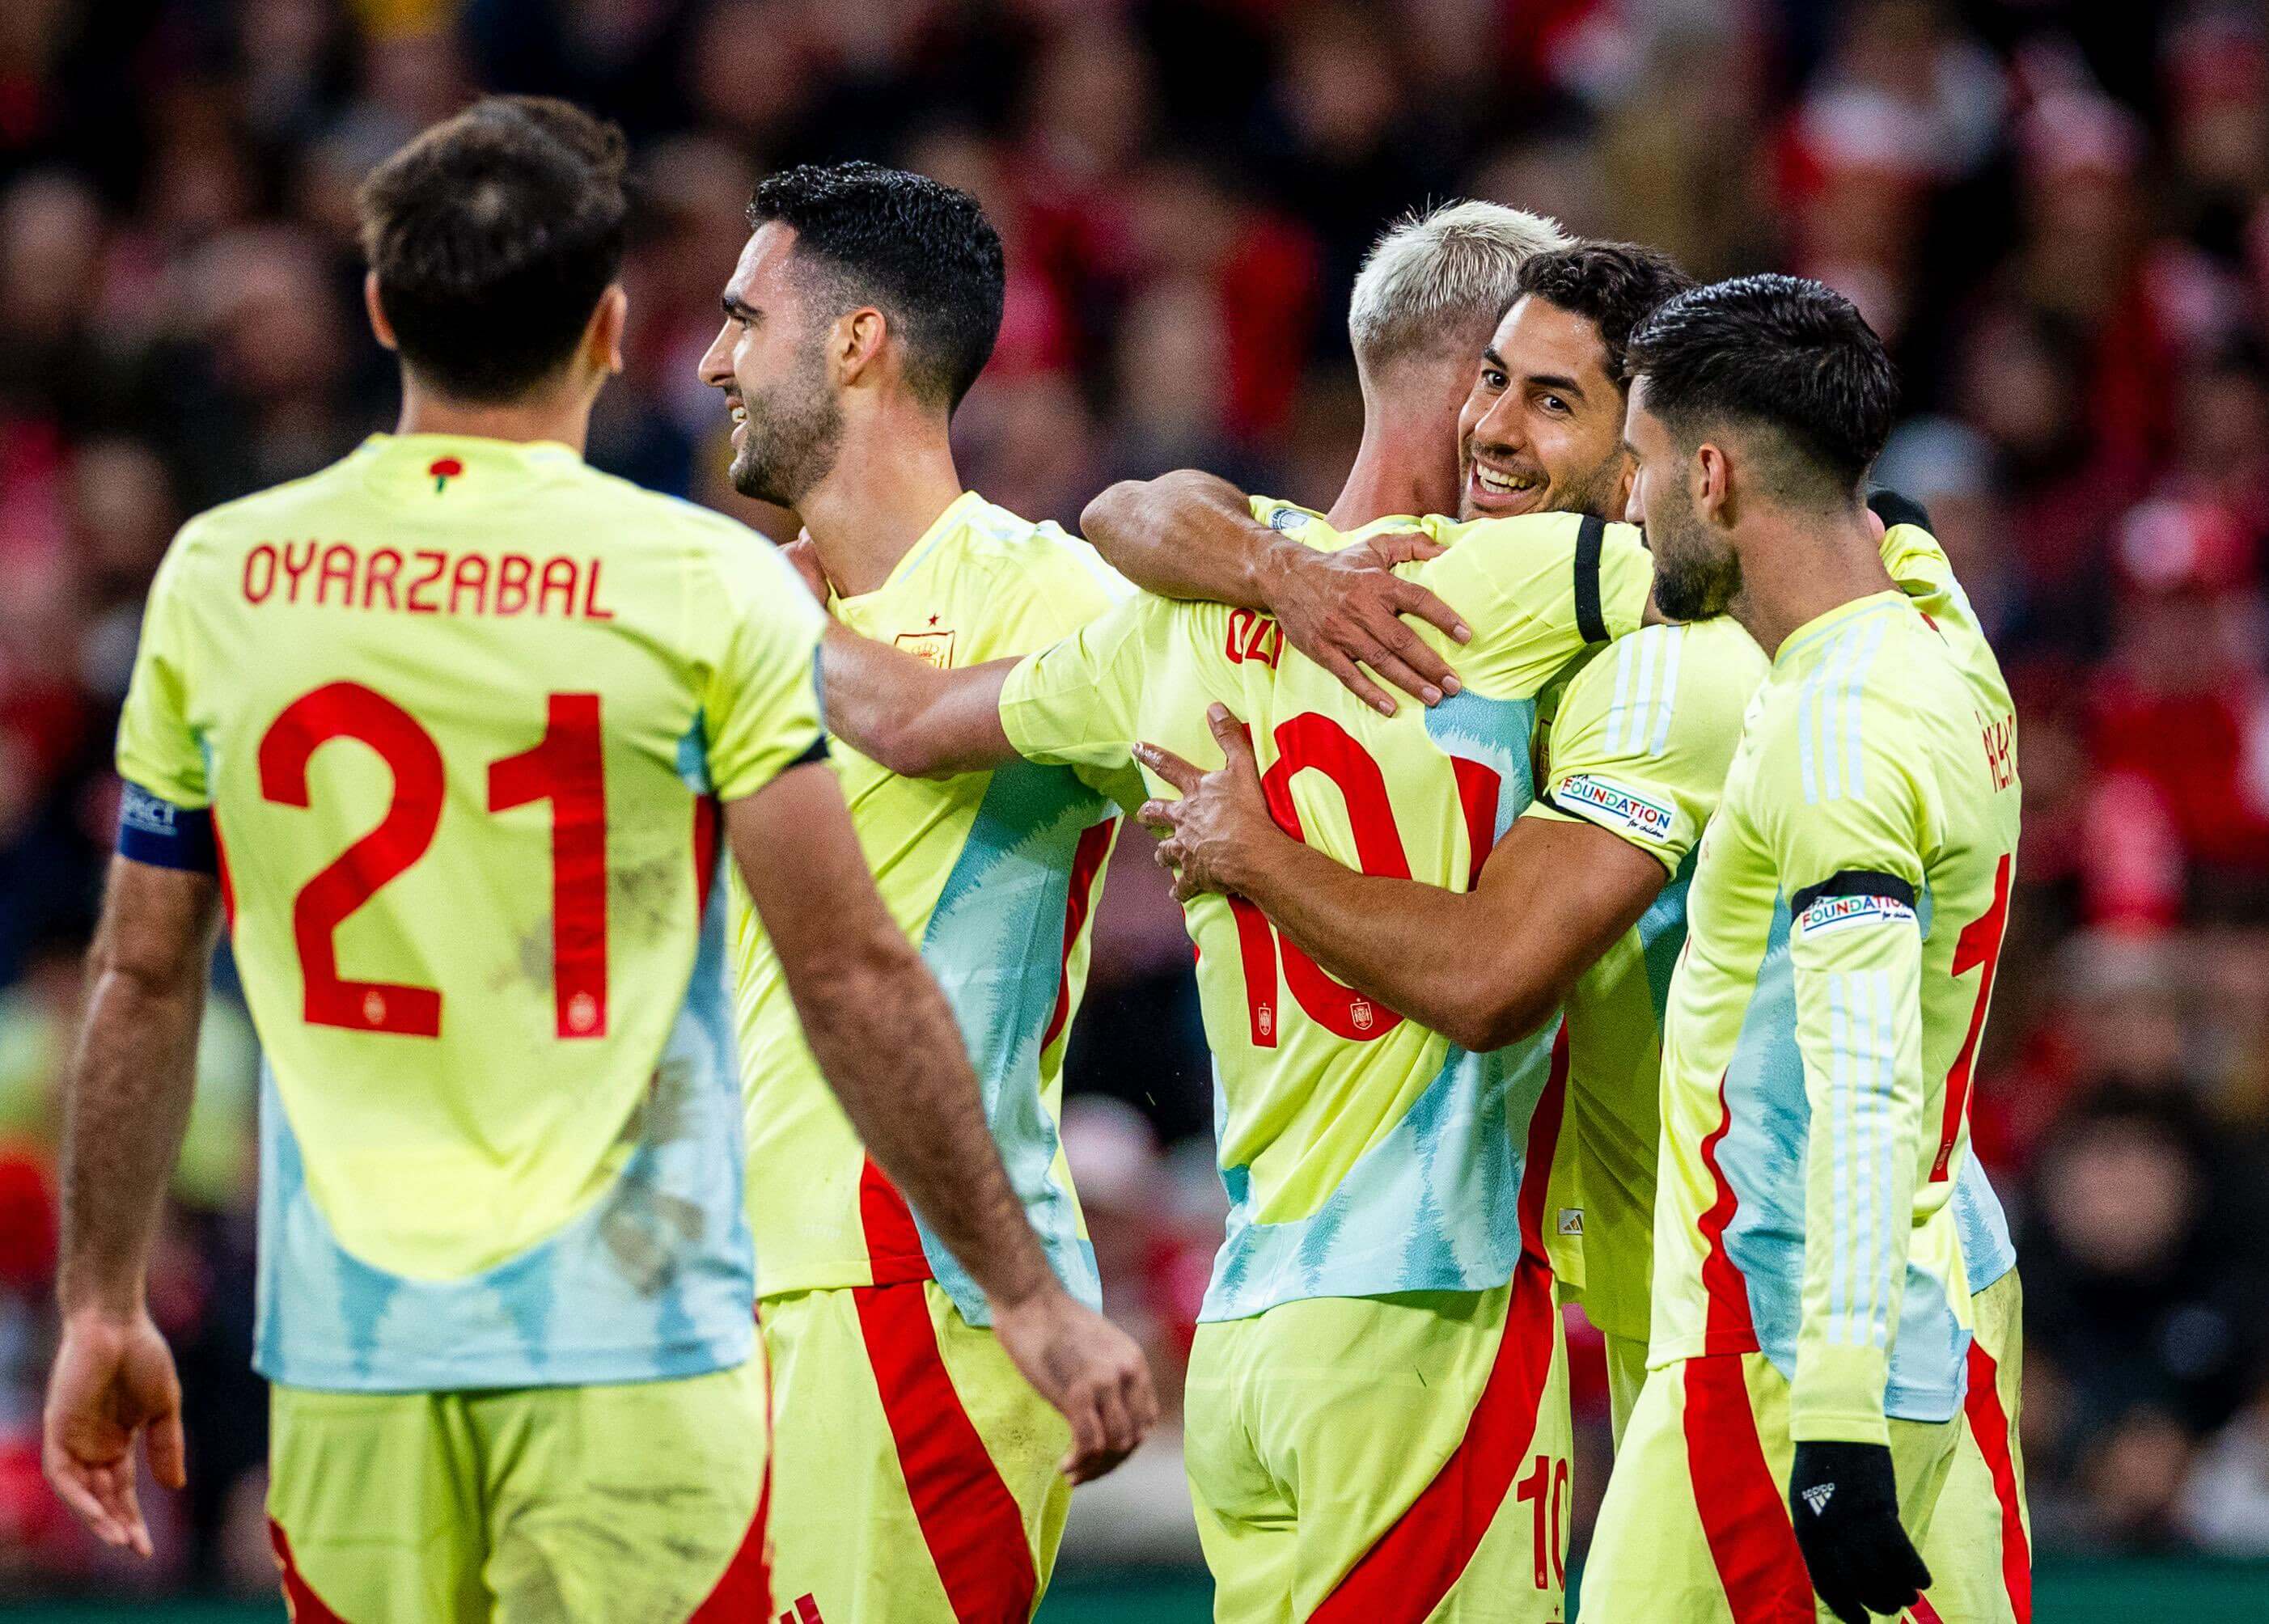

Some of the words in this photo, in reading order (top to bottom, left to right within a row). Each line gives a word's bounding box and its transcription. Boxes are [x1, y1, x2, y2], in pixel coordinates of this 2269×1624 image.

[243, 540, 616, 620] OYARZABAL
[1561, 777, 1671, 829] FOUNDATION
[257, 680, 608, 1039] 21
